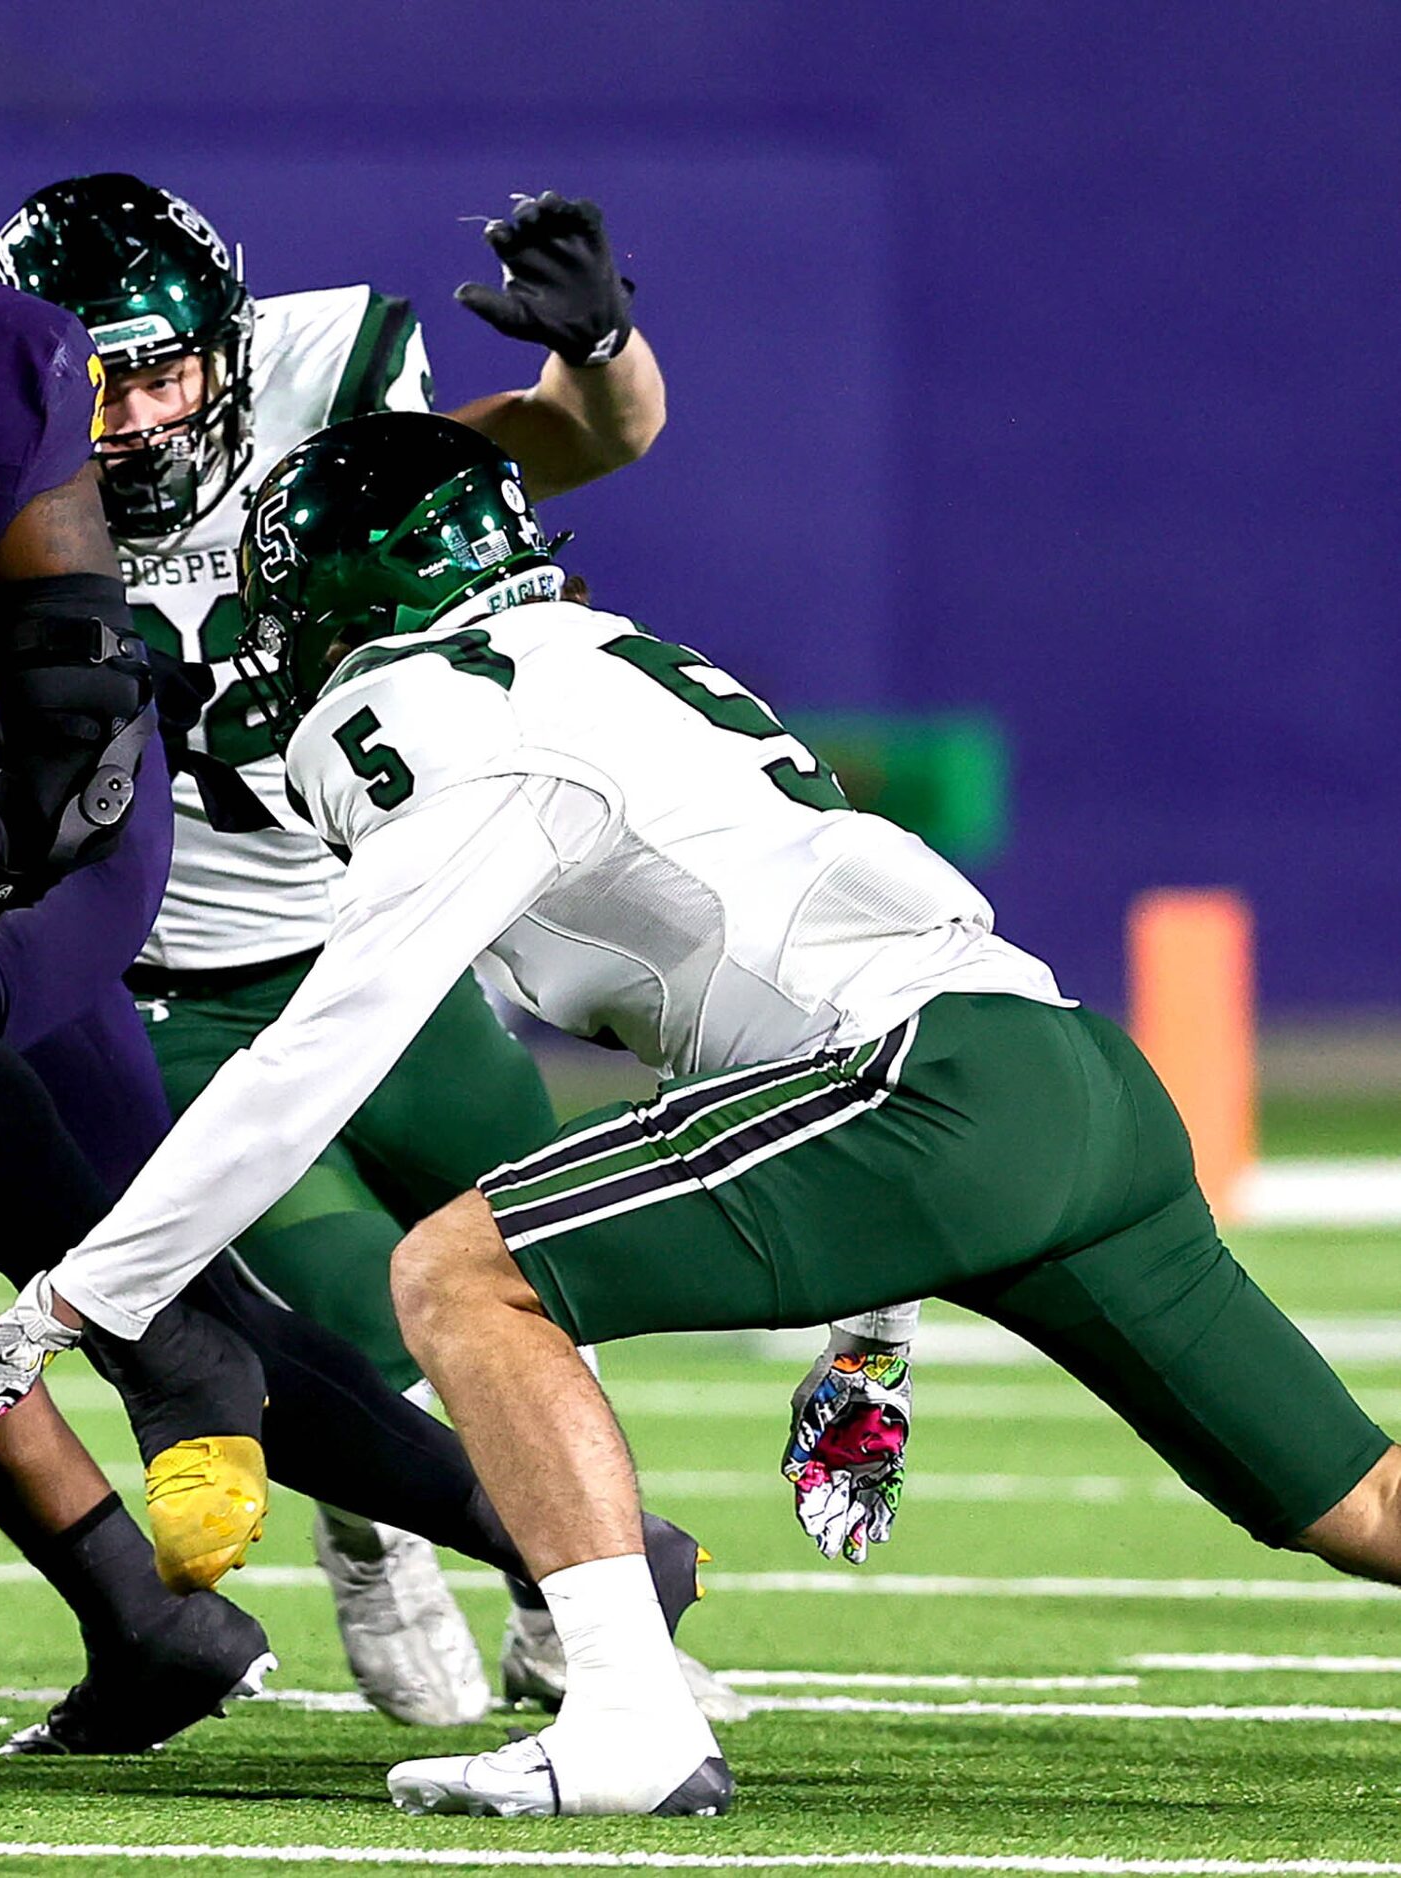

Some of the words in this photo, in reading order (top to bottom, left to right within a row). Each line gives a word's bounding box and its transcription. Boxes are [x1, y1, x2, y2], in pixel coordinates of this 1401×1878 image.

[118, 549, 241, 588] ROSPE
[256, 488, 296, 583] 5
[332, 704, 416, 811] 5
